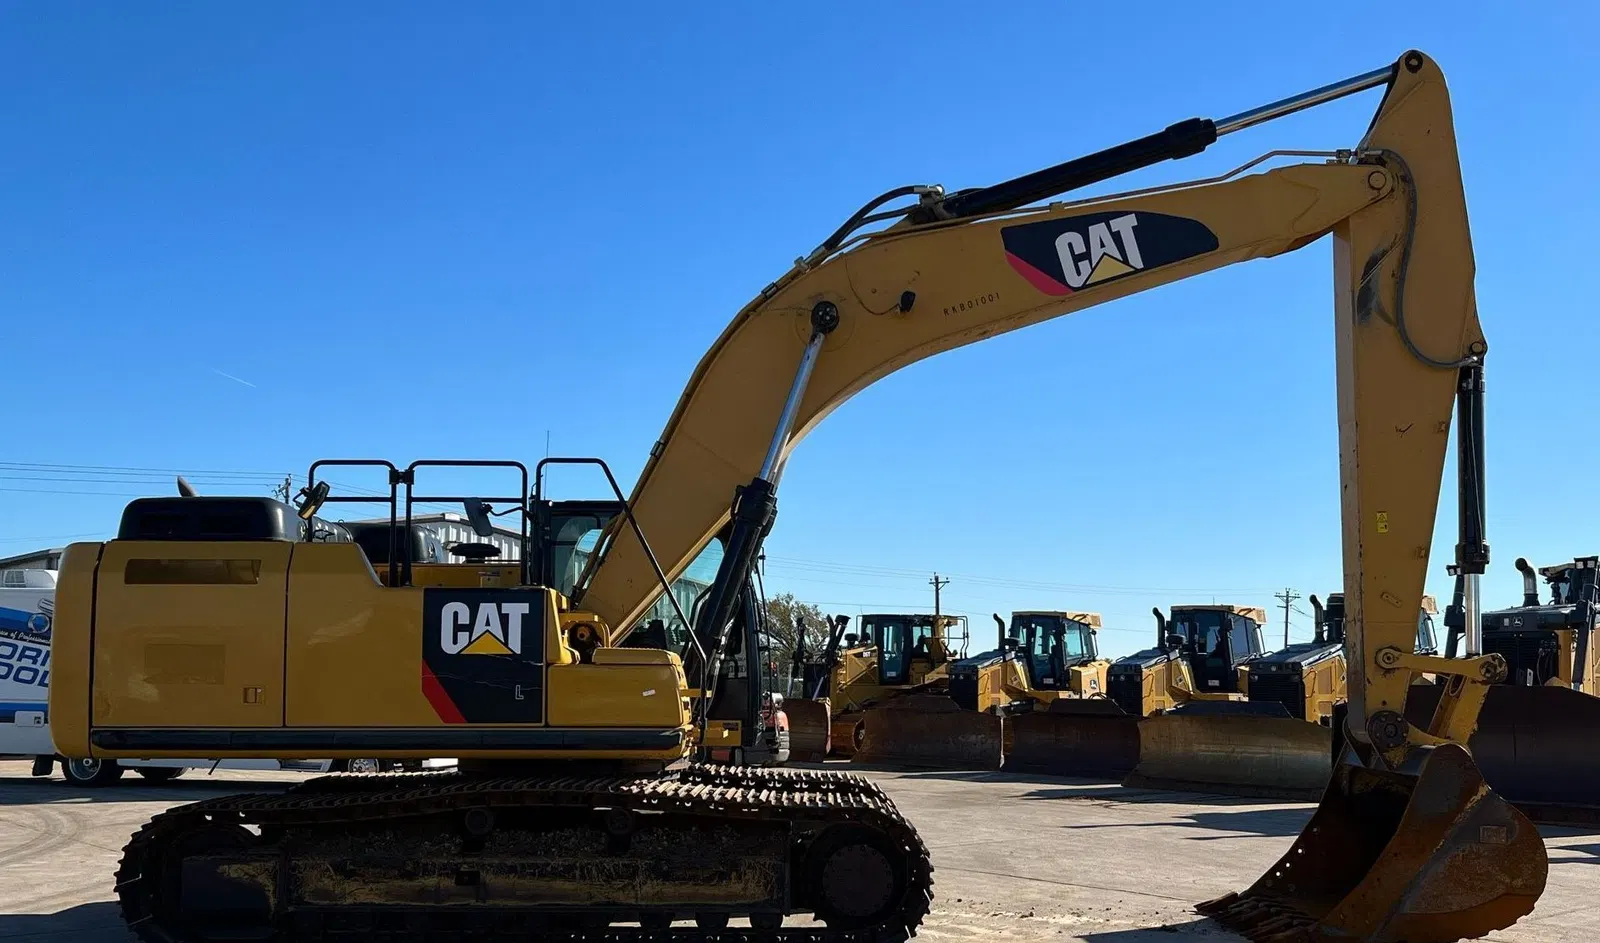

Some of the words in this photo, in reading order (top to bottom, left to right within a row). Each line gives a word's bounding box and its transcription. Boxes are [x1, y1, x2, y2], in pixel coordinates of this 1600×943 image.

[1055, 213, 1144, 287] CAT
[943, 292, 1000, 316] RKB01001
[441, 602, 529, 654] CAT
[515, 684, 524, 700] L
